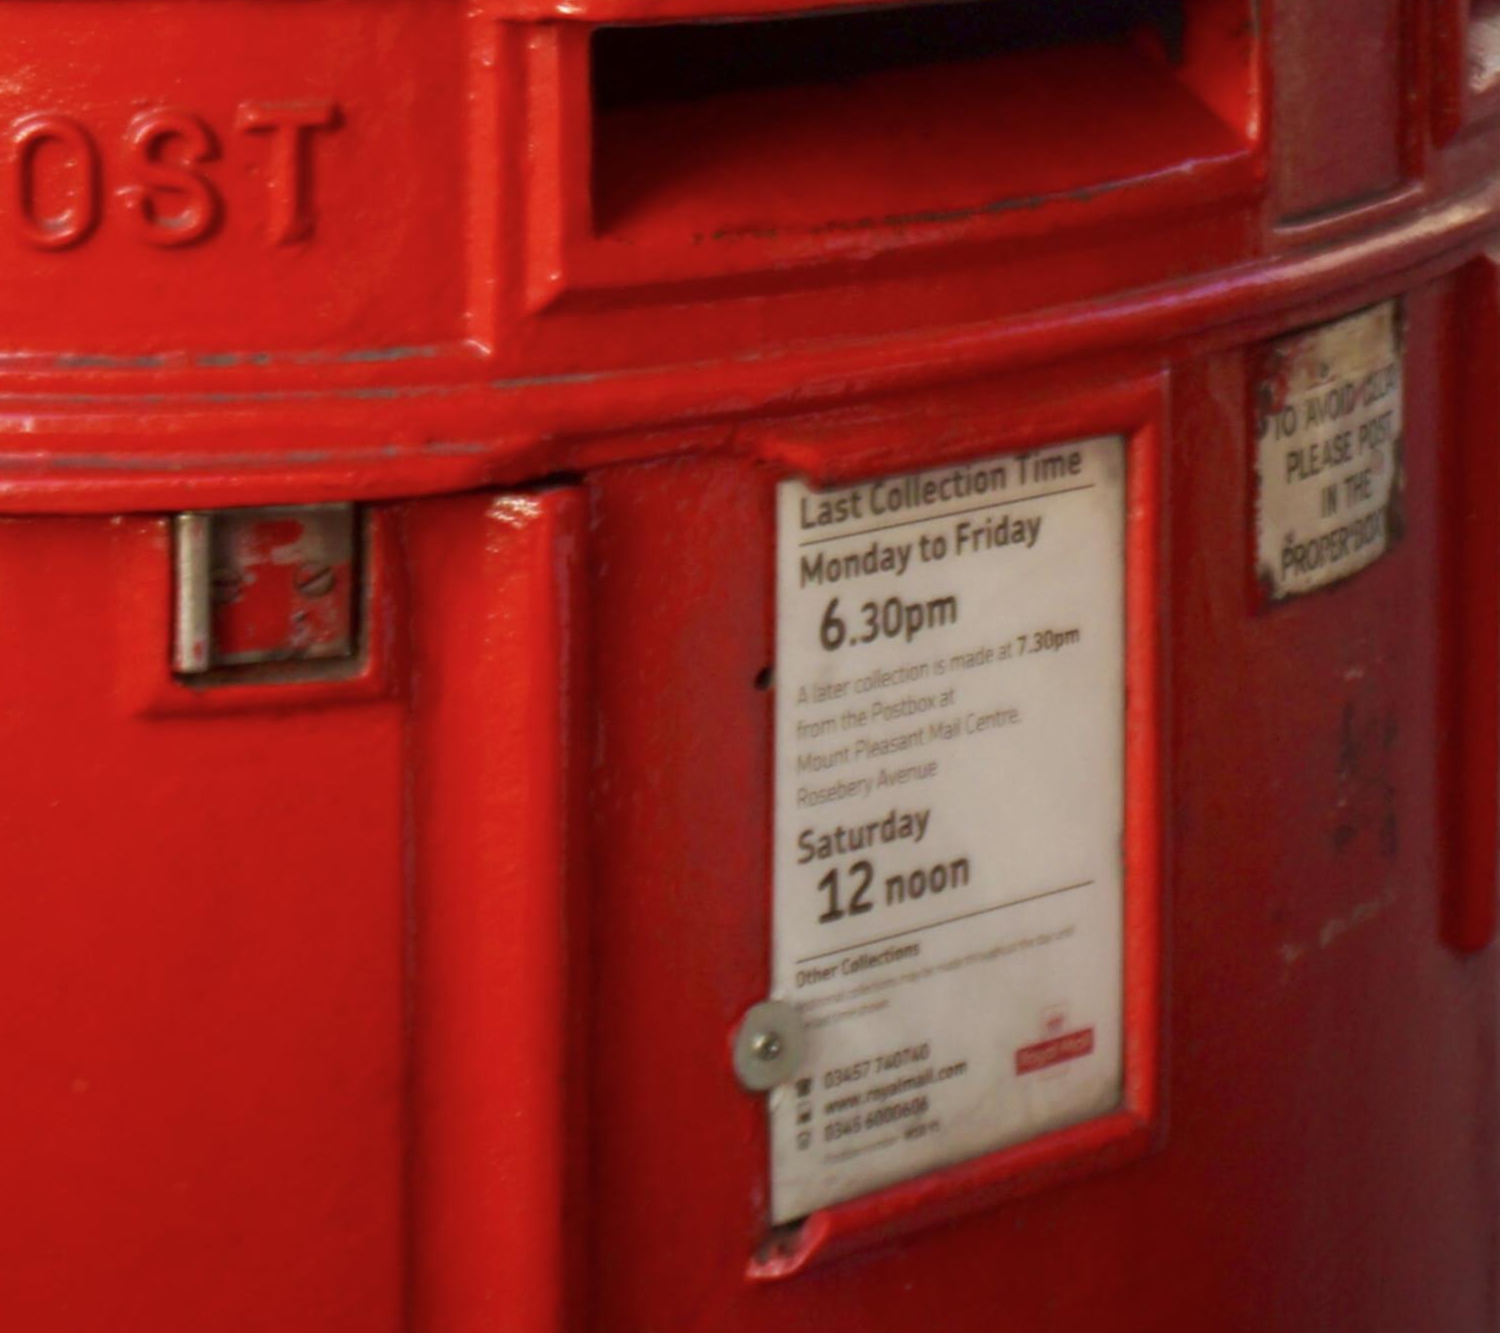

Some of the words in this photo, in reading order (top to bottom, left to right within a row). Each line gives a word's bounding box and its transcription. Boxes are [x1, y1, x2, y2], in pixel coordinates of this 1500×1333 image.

[1273, 403, 1297, 441] TO
[1304, 379, 1355, 432] AVOID
[1285, 428, 1352, 485] PLEASE
[800, 492, 862, 530] Last
[870, 464, 1007, 516] Collection
[1015, 451, 1082, 485] Time
[1320, 483, 1338, 519] IN
[1344, 467, 1373, 510] THE
[799, 542, 912, 589] Monday
[919, 534, 947, 563] to
[954, 514, 1042, 556] Friday
[1280, 525, 1349, 581] PROPER
[818, 595, 959, 652] 6.30pm
[796, 685, 809, 706] A
[813, 674, 850, 703] later
[855, 660, 930, 695] collection
[934, 655, 947, 676] is
[950, 644, 994, 671] made
[998, 639, 1014, 661] at
[1017, 627, 1081, 655] 7.30pm
[796, 717, 838, 741] from
[841, 709, 867, 732] the
[871, 694, 936, 725] Postbox
[939, 686, 956, 709] at
[796, 745, 850, 775] Mount
[854, 728, 925, 763] Pleasant
[928, 720, 962, 745] Mail
[796, 778, 874, 809] Rosebery
[877, 760, 939, 789] Avenue
[797, 809, 931, 866] Saturday
[817, 858, 875, 925] 12
[884, 856, 971, 907] noon
[796, 966, 838, 989] Other
[842, 942, 921, 976] Collections
[824, 1060, 871, 1090] 03457
